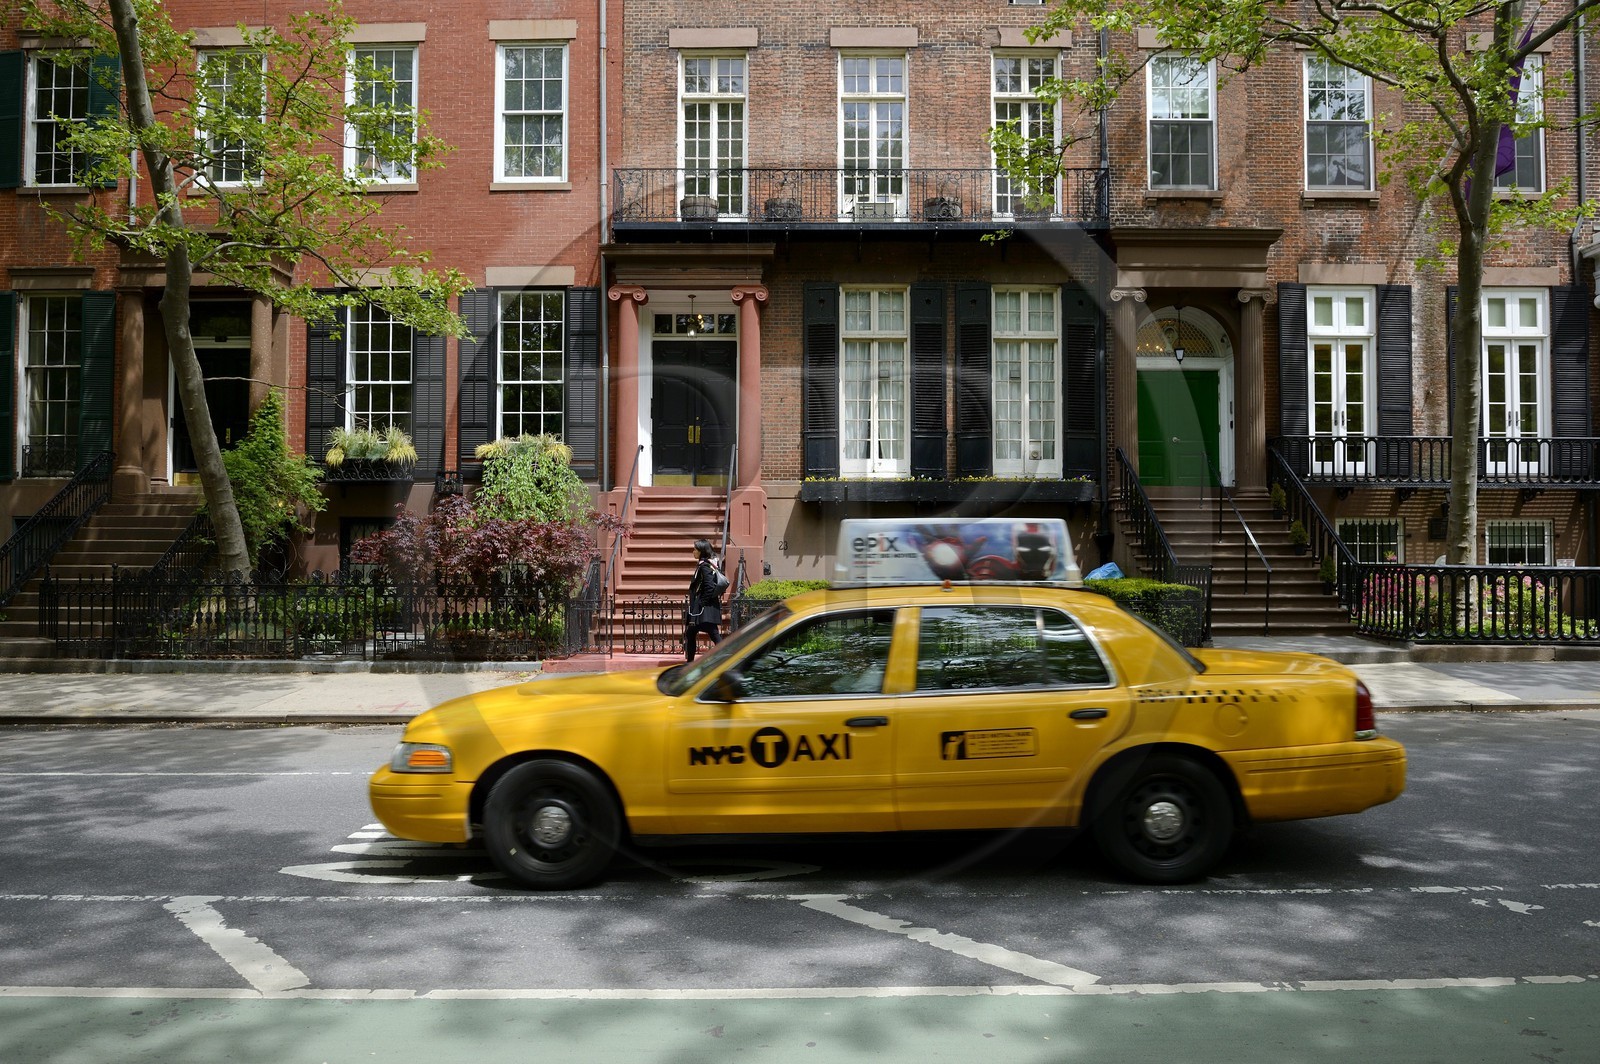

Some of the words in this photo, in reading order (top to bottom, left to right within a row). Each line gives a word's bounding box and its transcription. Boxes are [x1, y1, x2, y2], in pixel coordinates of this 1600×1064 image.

[778, 540, 788, 551] 23
[853, 533, 899, 552] epix
[689, 745, 746, 766] NYC
[752, 729, 852, 766] TAXI
